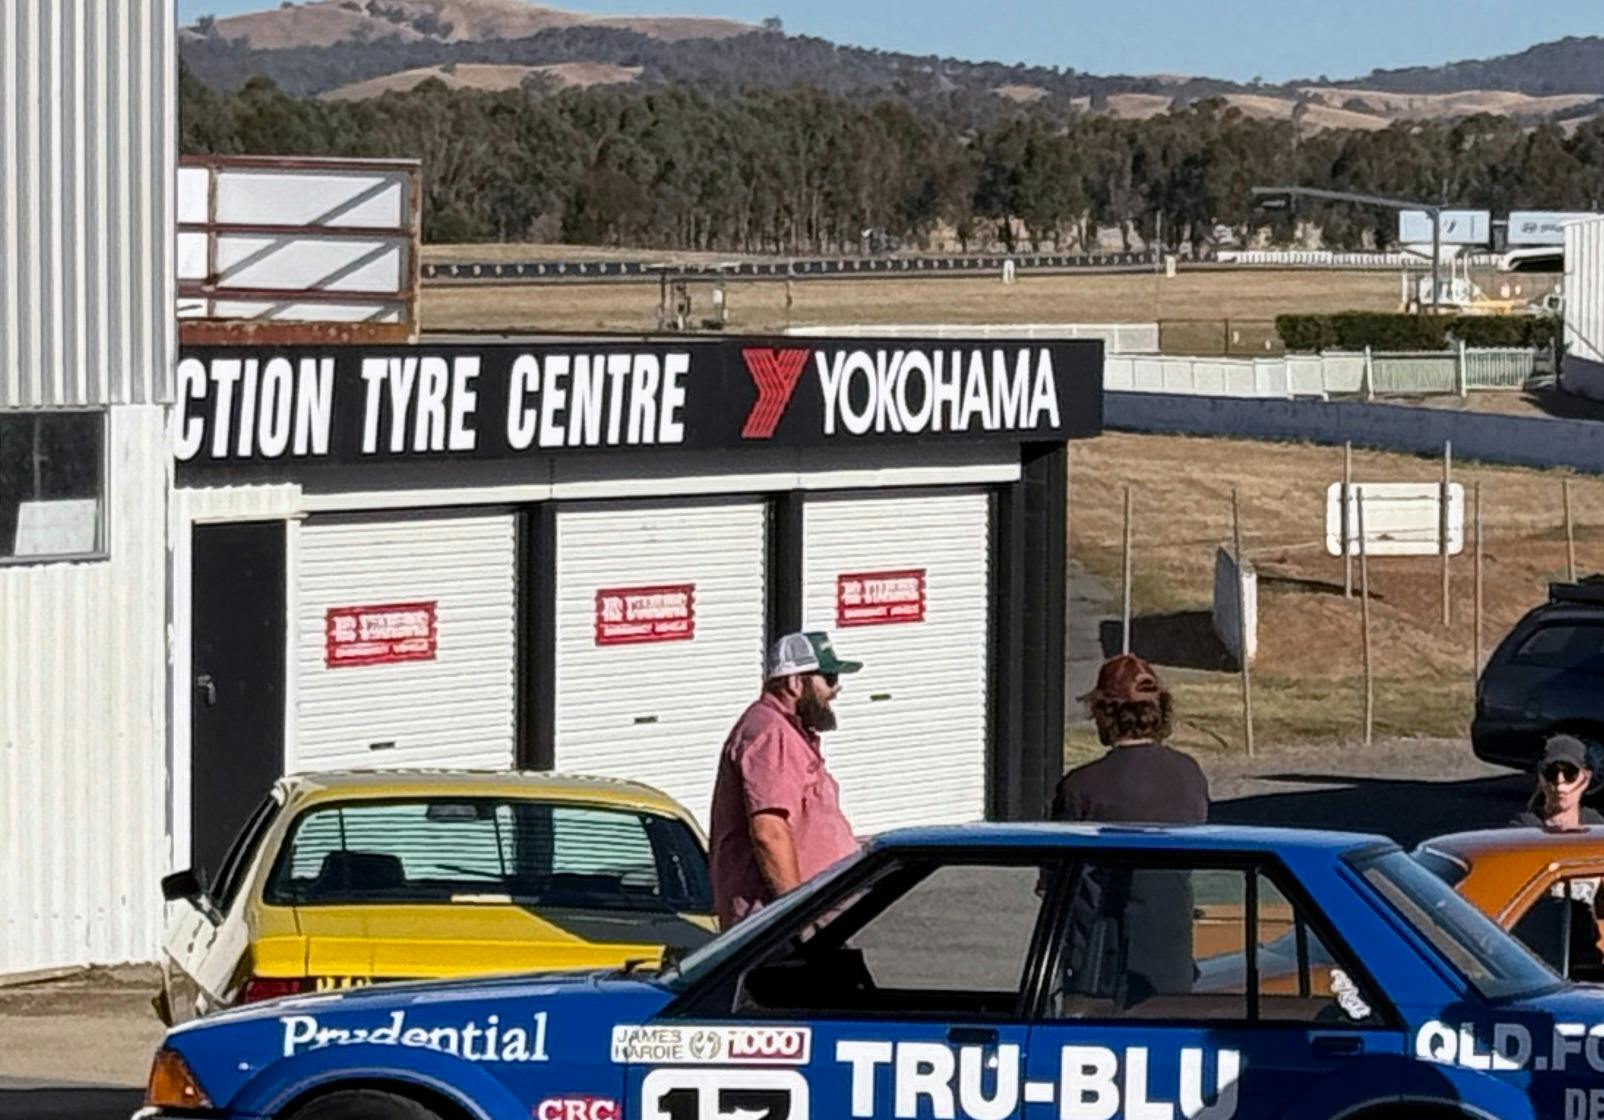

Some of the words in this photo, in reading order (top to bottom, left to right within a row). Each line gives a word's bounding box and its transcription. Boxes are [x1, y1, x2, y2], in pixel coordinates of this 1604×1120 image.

[361, 355, 481, 454] TYRE
[506, 352, 690, 450] CENTRE
[814, 348, 1061, 435] YOKOHAMA
[279, 1010, 550, 1062] Prudential
[615, 1045, 684, 1060] HARDIE
[616, 1029, 682, 1044] JAMES
[728, 1030, 801, 1056] 1000
